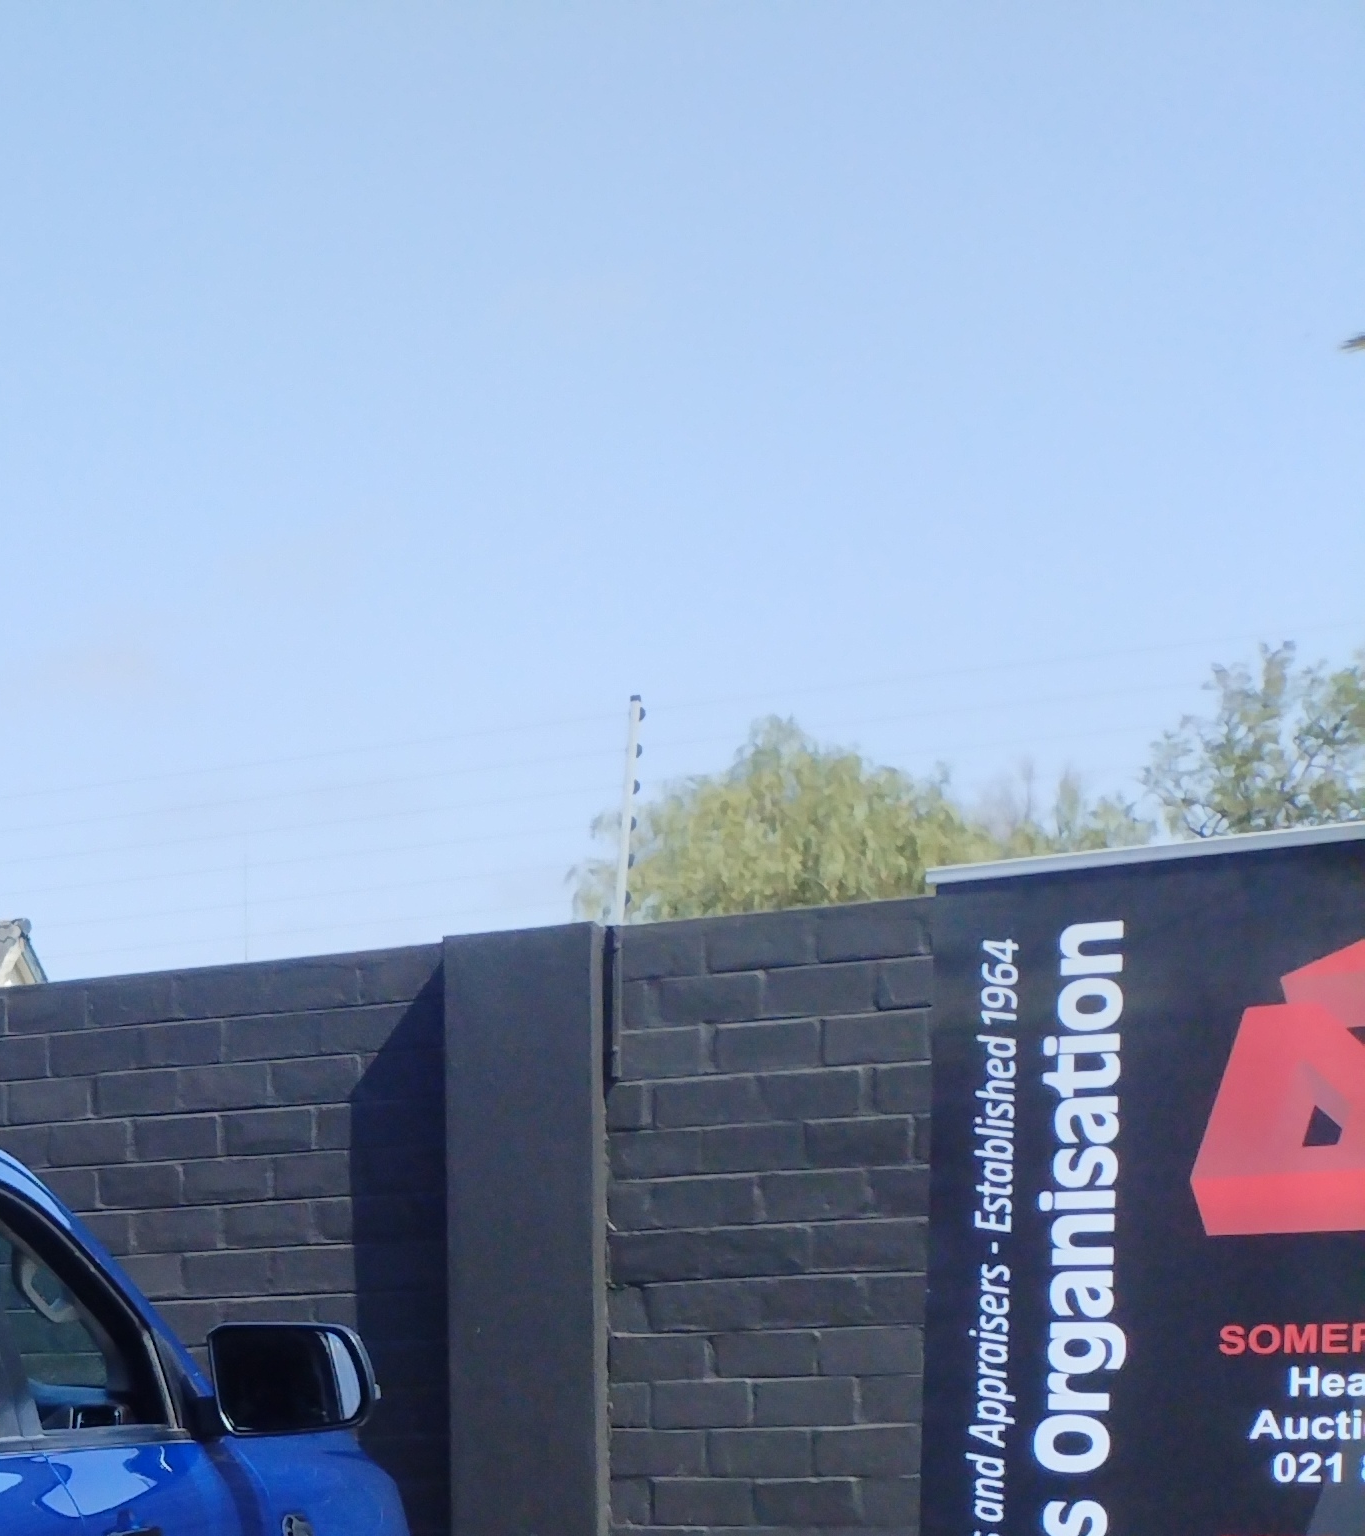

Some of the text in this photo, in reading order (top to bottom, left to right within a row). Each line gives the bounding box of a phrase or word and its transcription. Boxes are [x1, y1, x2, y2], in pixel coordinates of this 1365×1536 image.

[980, 938, 1020, 1026] 1964
[975, 1035, 1018, 1233] Established
[1034, 919, 1127, 1474] Organisation
[968, 1263, 1016, 1448] Appraisers
[966, 1455, 1006, 1522] and
[1273, 1452, 1343, 1483] 021
